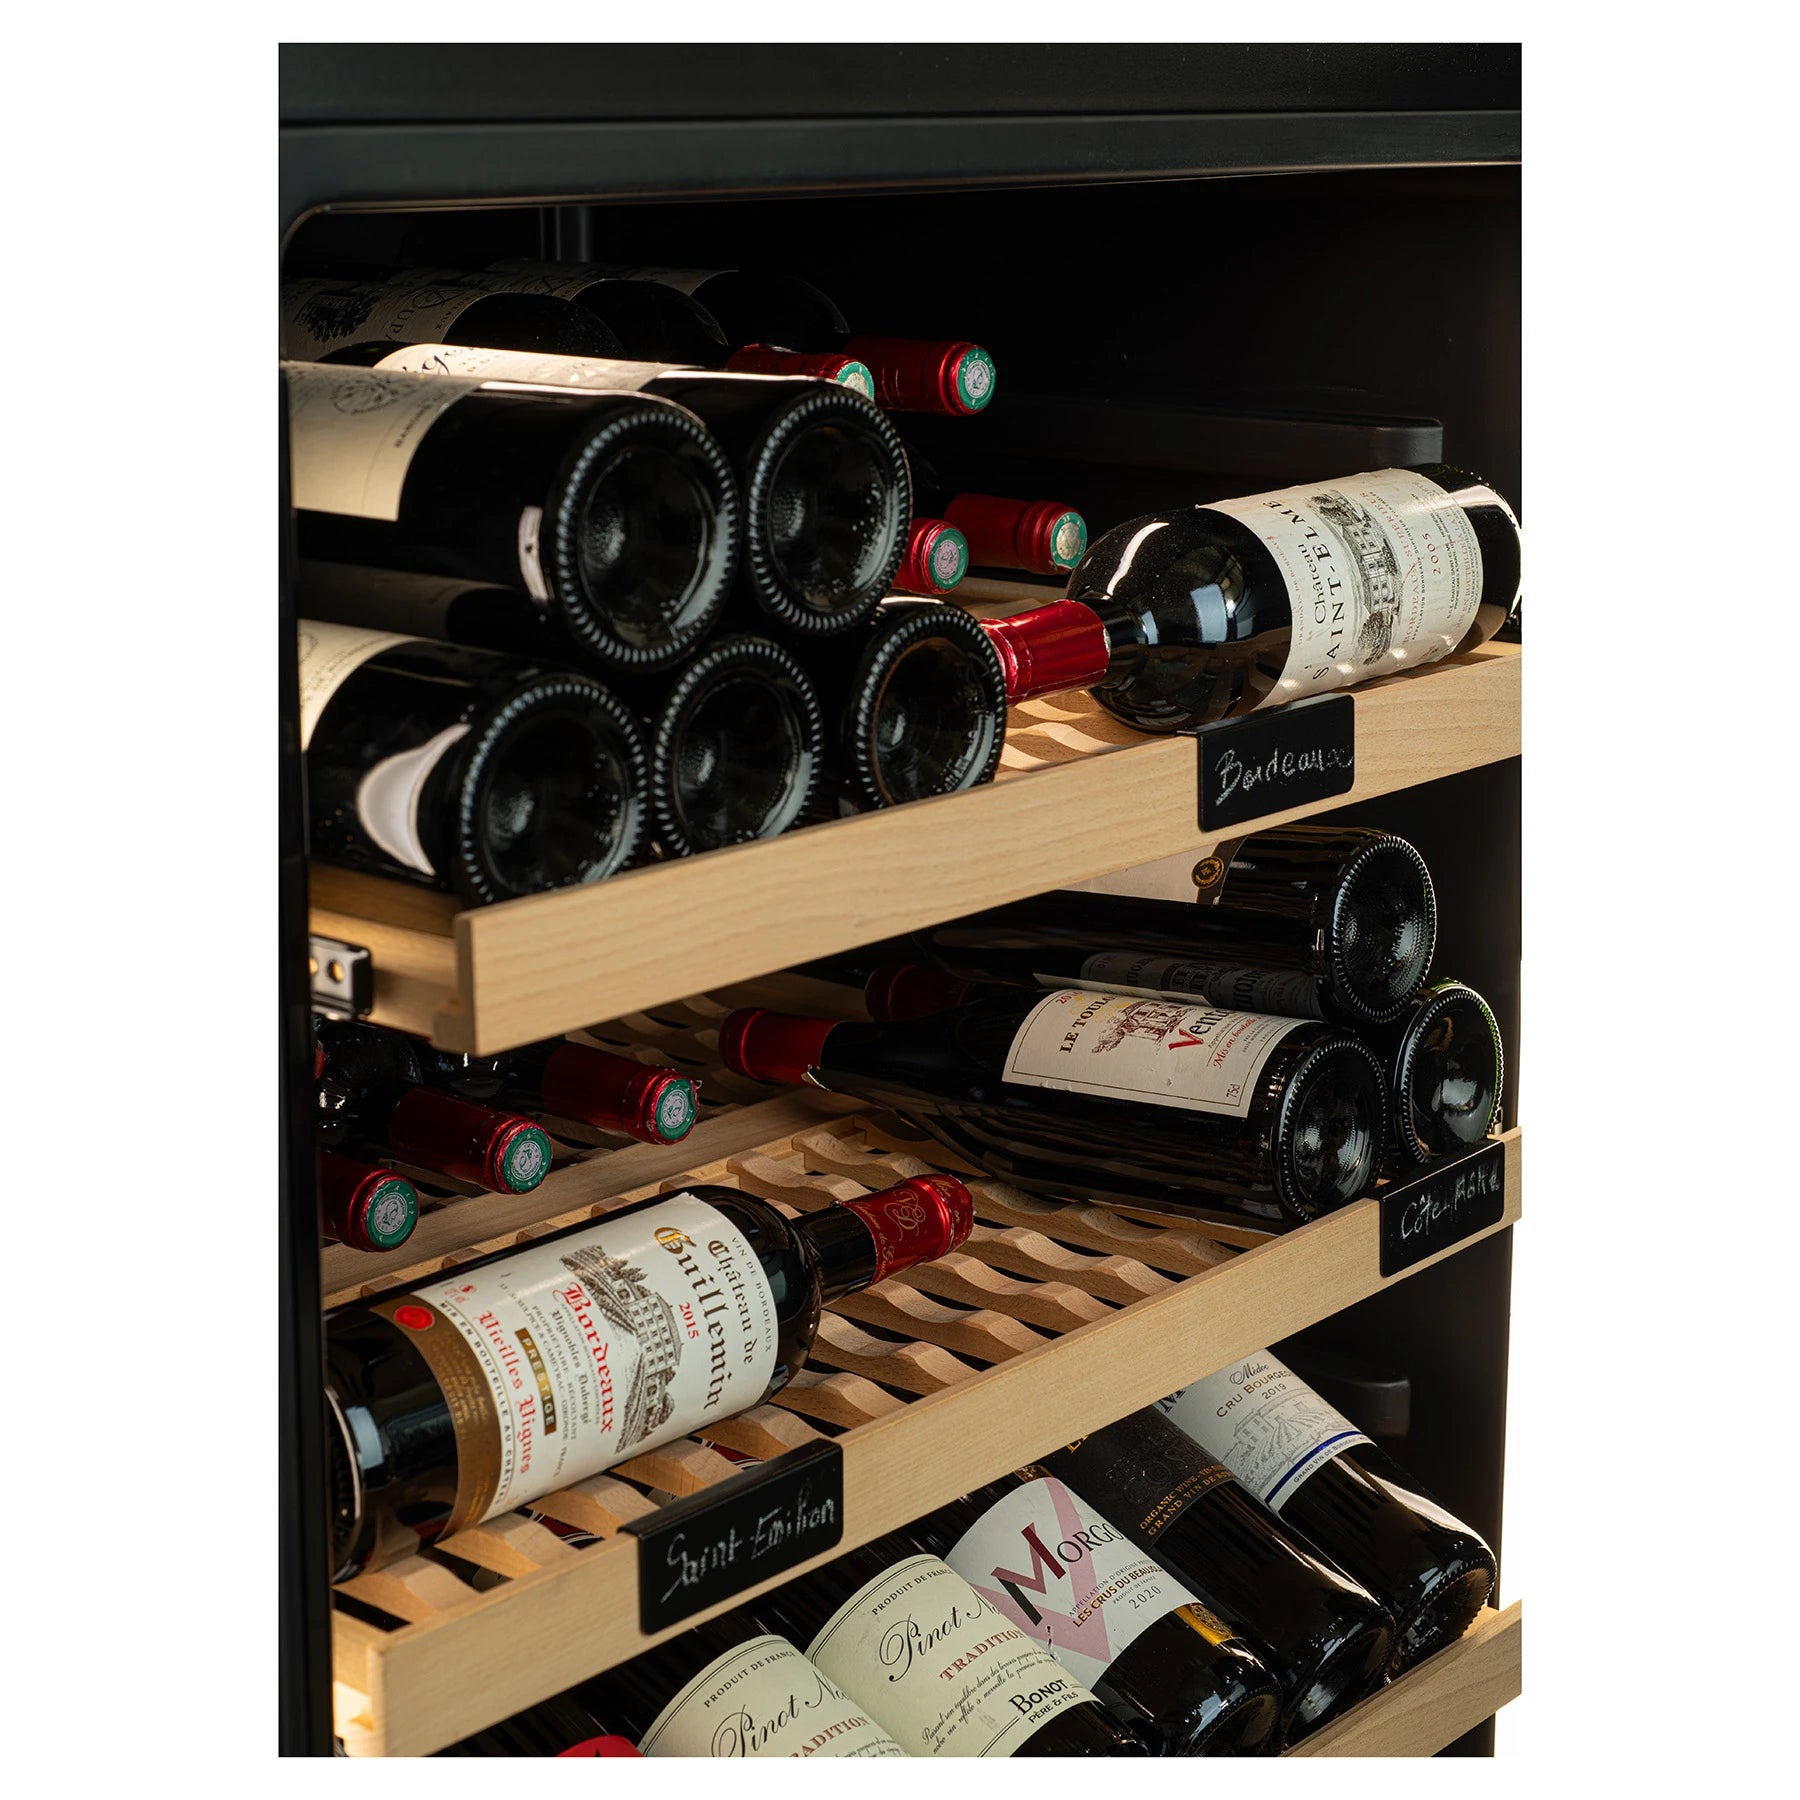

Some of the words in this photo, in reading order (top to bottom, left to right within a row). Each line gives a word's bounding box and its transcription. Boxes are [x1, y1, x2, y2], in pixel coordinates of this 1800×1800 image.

[1422, 532, 1441, 576] 2005
[1298, 544, 1326, 624] Château
[1060, 1032, 1079, 1054] LE
[1212, 1046, 1229, 1069] Mis
[707, 1239, 754, 1333] Château
[742, 1337, 758, 1366] de
[730, 1236, 747, 1257] VIN
[746, 1261, 758, 1278] DE
[755, 1282, 773, 1353] BORDEAUX
[551, 1309, 581, 1369] Vignobles
[678, 1301, 700, 1340] 2015
[439, 1302, 458, 1318] MIS
[458, 1320, 473, 1336] EN
[473, 1340, 510, 1417] BOUTEILLE
[503, 1424, 512, 1443] AU
[552, 1281, 615, 1435] Bordeaux
[1229, 1362, 1270, 1386] Médoc
[473, 1309, 524, 1391] Vieilles
[515, 1393, 537, 1475] Vignes
[521, 1337, 555, 1426] PRESTIGE
[1261, 1382, 1288, 1400] 2019
[1216, 1393, 1244, 1419] CRU
[1293, 1463, 1314, 1483] GRAND
[1314, 1455, 1325, 1465] VIN
[1139, 1491, 1177, 1531] ORGANIC
[1174, 1476, 1198, 1494] WINE
[1147, 1500, 1184, 1536] GRAND
[1183, 1484, 1202, 1499] VIN
[1202, 1477, 1217, 1486] DE
[871, 1581, 914, 1616] PRODUIT
[914, 1574, 928, 1586] DE
[1068, 1578, 1110, 1617] APPELLATION
[1072, 1607, 1093, 1629] LES
[1090, 1585, 1118, 1611] CRUS
[1116, 1576, 1132, 1590] DU
[1128, 1583, 1162, 1610] 2020
[878, 1606, 963, 1683] Pinot
[939, 1628, 1027, 1682] TRADITION
[703, 1667, 750, 1709] PRODUIT
[749, 1658, 765, 1673] DE
[975, 1671, 991, 1689] dans
[989, 1664, 1000, 1679] des
[1007, 1679, 1069, 1716] BONOT
[711, 1694, 800, 1757] Pinot
[1028, 1705, 1054, 1724] PÈRE
[1053, 1698, 1063, 1708] &
[1062, 1690, 1079, 1703] FILS
[791, 1716, 871, 1757] ADITION
[947, 1723, 957, 1736] vin
